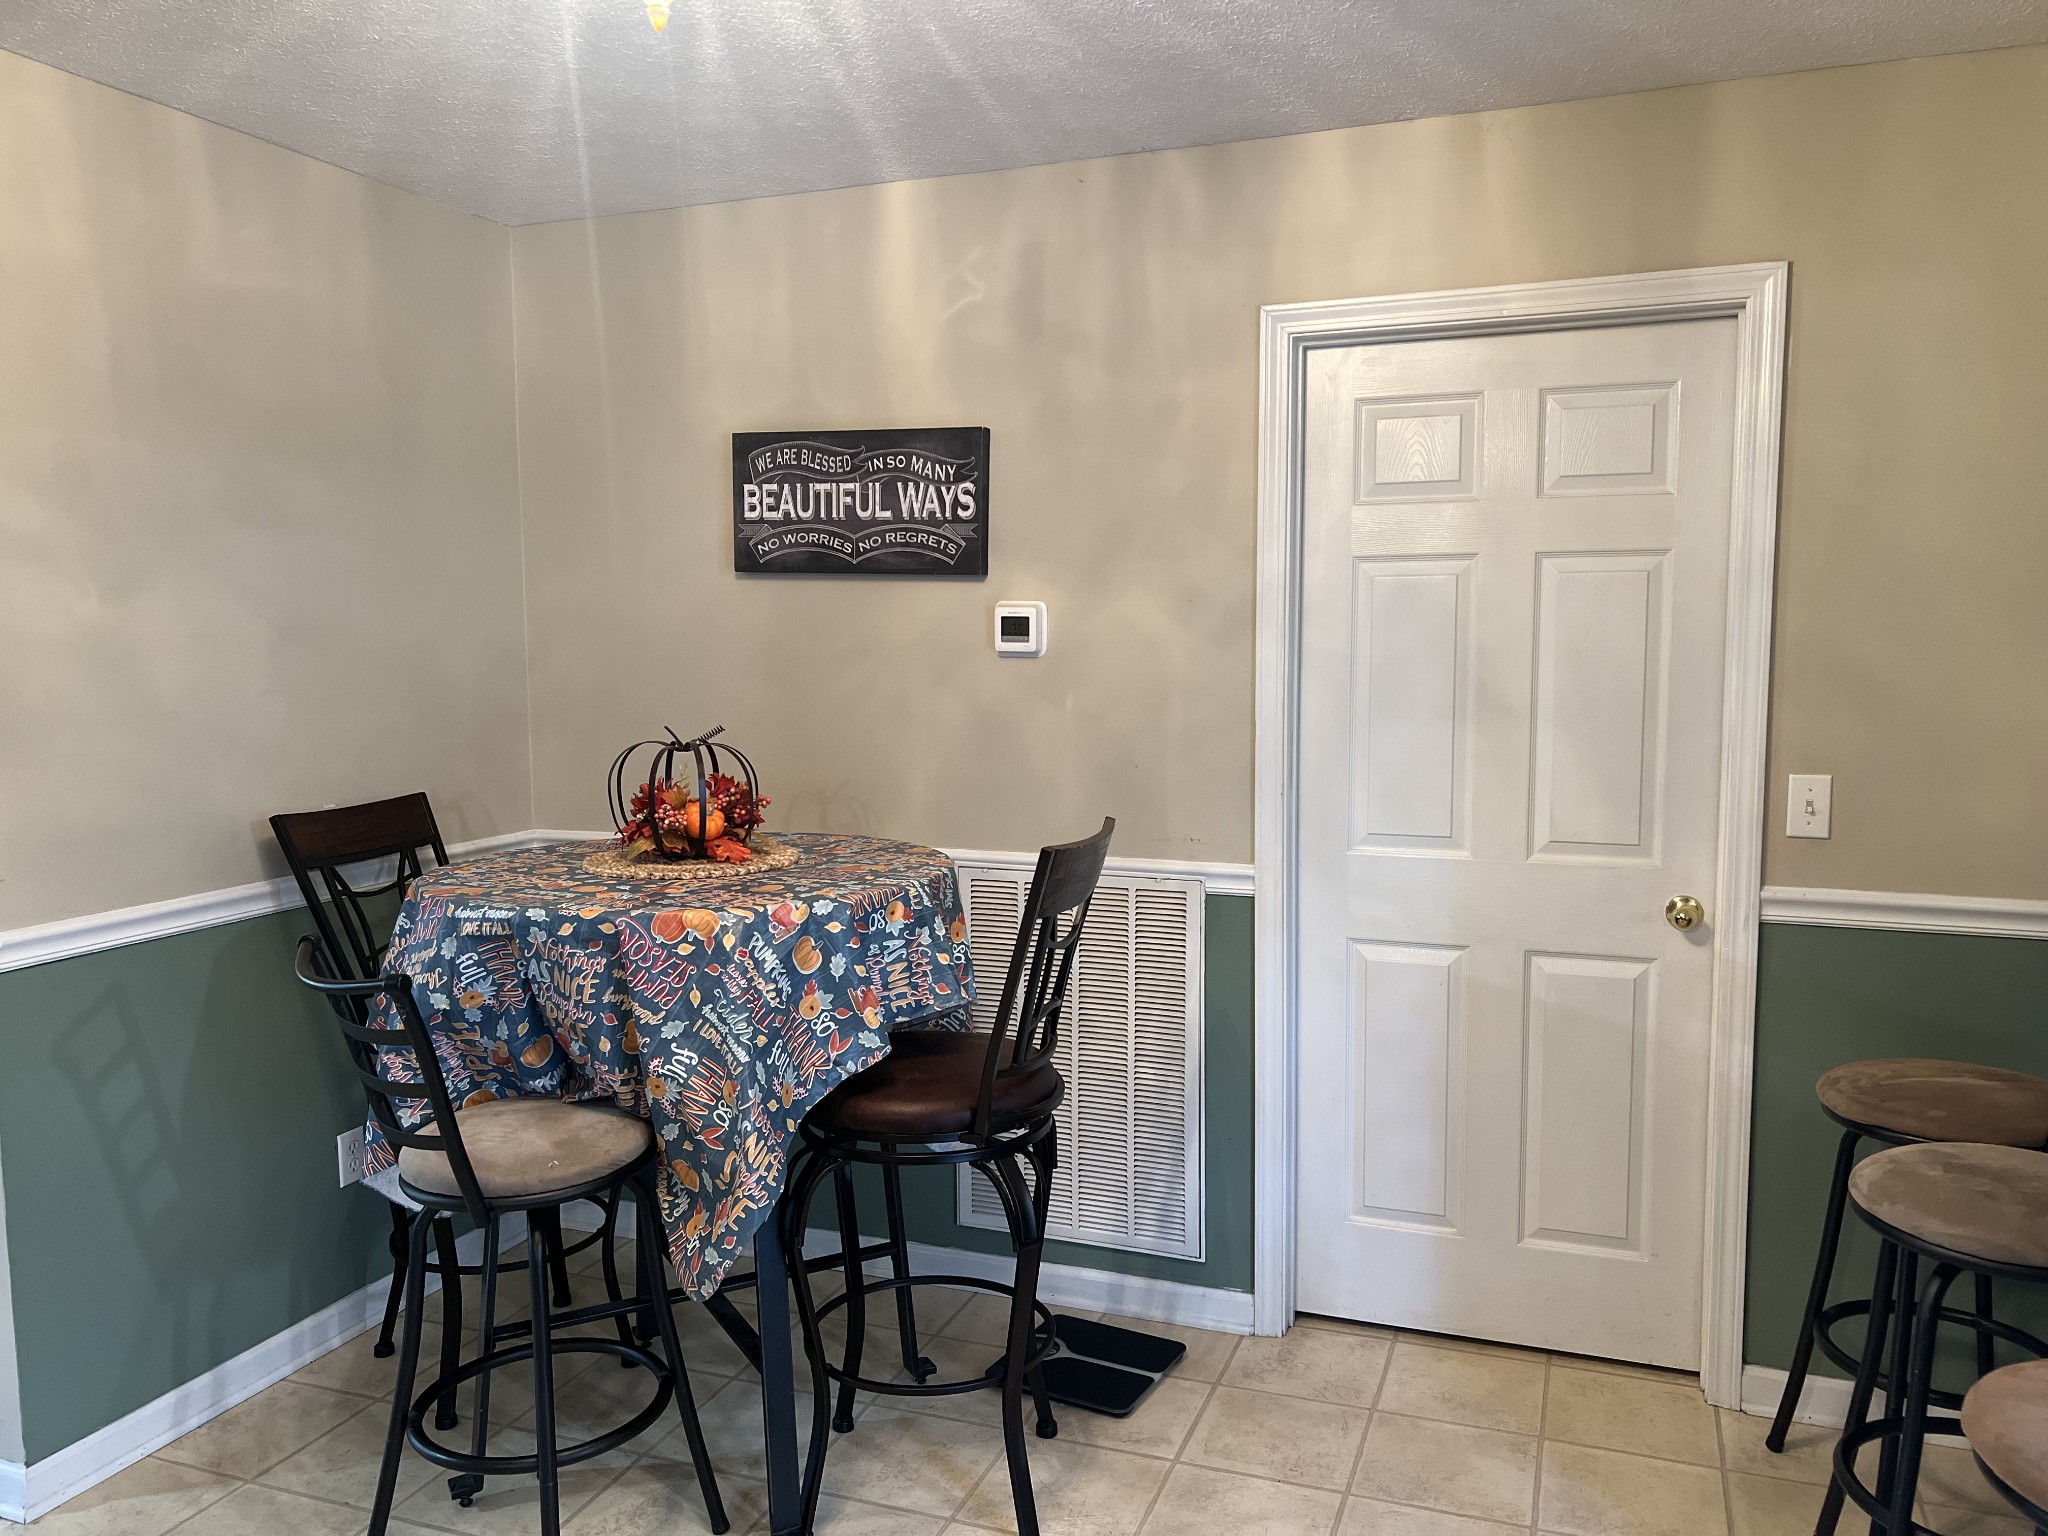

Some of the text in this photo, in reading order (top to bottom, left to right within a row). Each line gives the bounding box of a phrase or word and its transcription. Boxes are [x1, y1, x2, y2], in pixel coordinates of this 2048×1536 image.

[755, 448, 957, 482] WE ARE BLESSED IN SO MANY
[743, 481, 976, 521] BEAUTIFUL WAYS
[757, 531, 958, 555] NO WORRIES NO REGRETS
[616, 916, 697, 988] SEASON
[528, 958, 551, 982] AS
[553, 965, 599, 1004] NICE
[883, 939, 916, 1013] AS NICE
[737, 988, 774, 1032] FALL
[700, 1021, 721, 1049] LOVE
[744, 1131, 783, 1187] NICE
